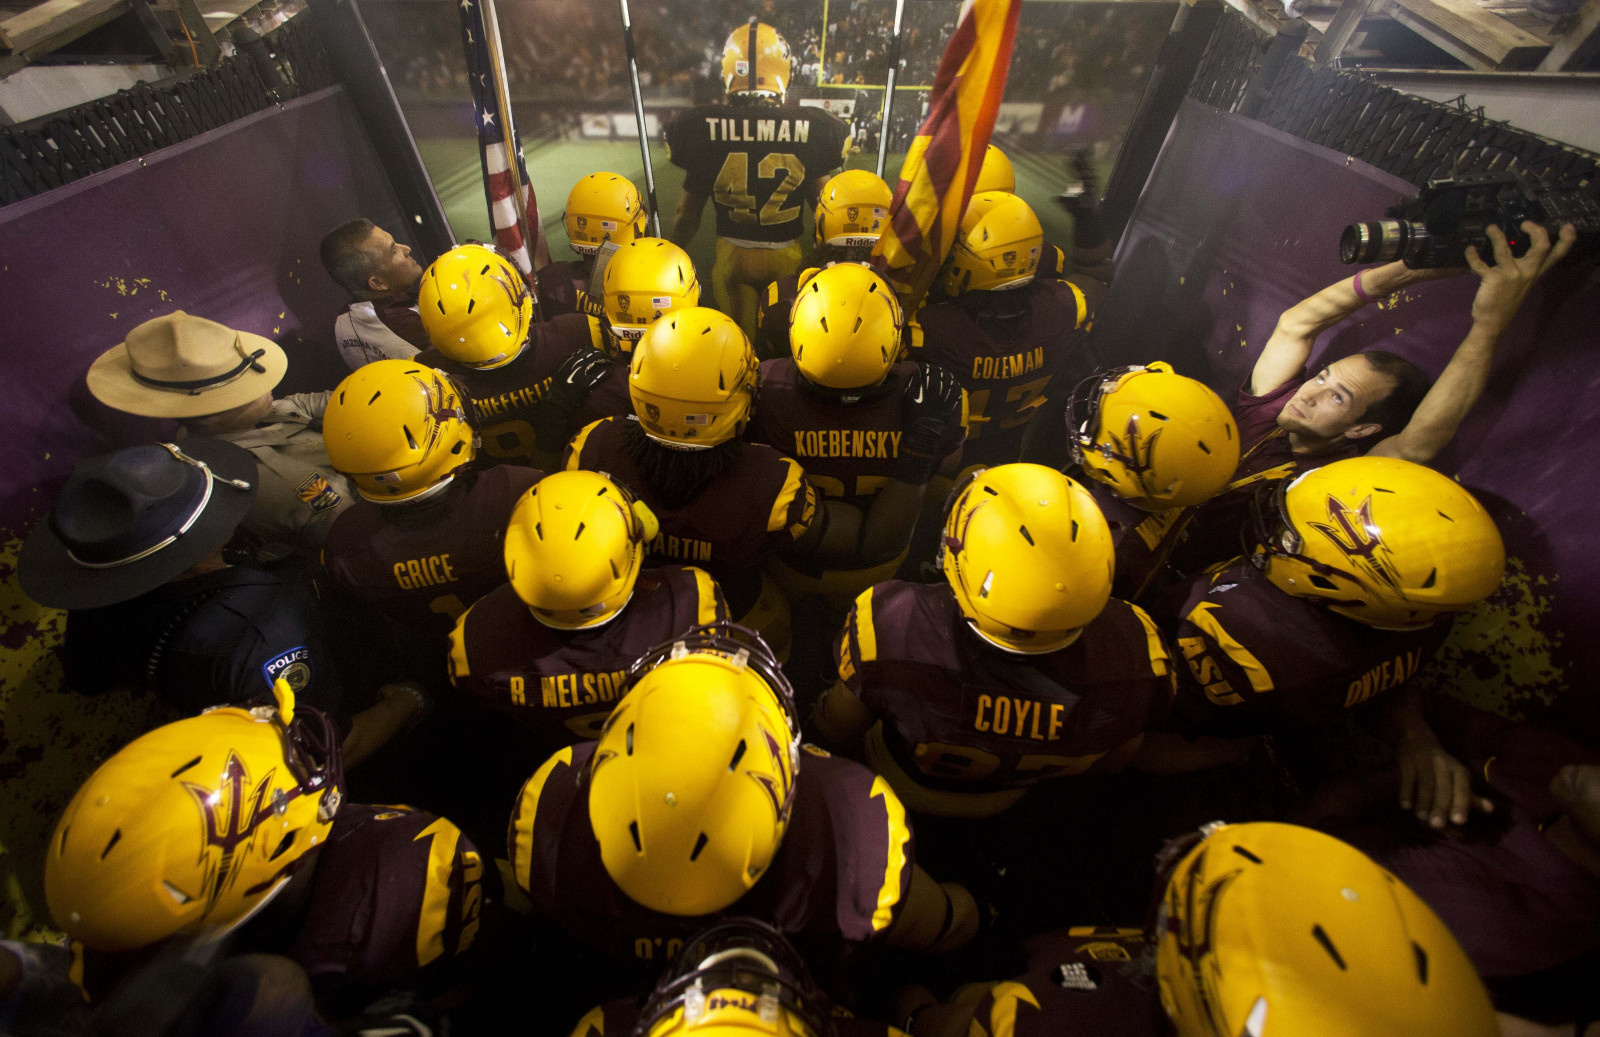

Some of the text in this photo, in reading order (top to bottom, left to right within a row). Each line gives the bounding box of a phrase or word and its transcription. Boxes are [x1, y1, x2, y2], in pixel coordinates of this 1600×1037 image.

[705, 117, 810, 143] TILLMAN
[713, 152, 806, 226] 42
[845, 237, 878, 246] Ridde
[575, 289, 607, 316] YOU
[622, 329, 645, 340] Rid
[972, 346, 1044, 380] COLEMAN
[794, 429, 903, 459] KOEBENSKY
[653, 531, 712, 562] ARTIN
[392, 553, 460, 591] GRICE
[266, 649, 309, 675] POLICE
[1177, 636, 1245, 706] ASU
[974, 693, 1065, 741] COYLE
